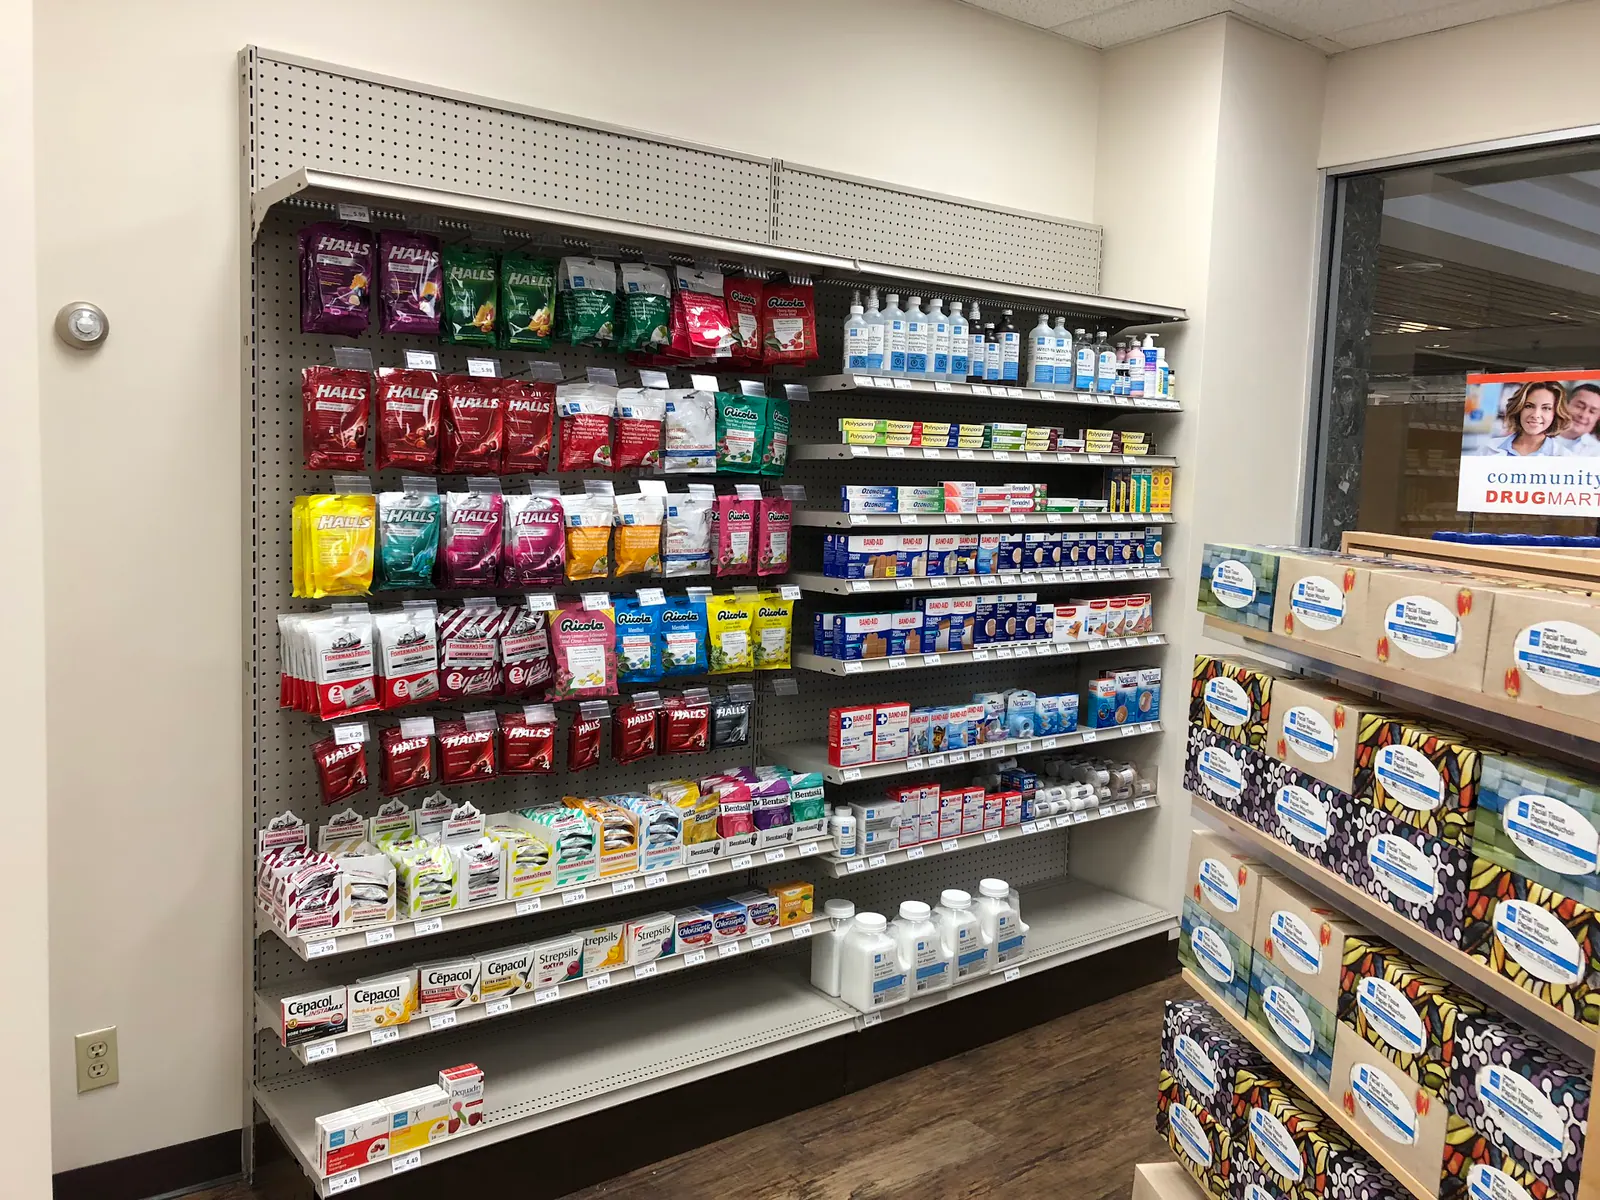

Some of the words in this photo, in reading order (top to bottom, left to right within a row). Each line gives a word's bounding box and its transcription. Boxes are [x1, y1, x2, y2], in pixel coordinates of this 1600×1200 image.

[319, 237, 370, 255] HALLS
[389, 245, 439, 262] HALLS
[450, 266, 494, 280] HALLS
[509, 273, 552, 287] HALLS
[768, 297, 806, 308] Ricola
[316, 384, 366, 400] HALLS
[386, 385, 438, 400] HALLS
[453, 396, 499, 409] HALLS
[509, 400, 549, 412] HALLS
[724, 406, 758, 420] Ricola
[1488, 470, 1600, 489] community
[1486, 491, 1600, 506] DRUGMART
[386, 509, 436, 523] HALLS
[453, 509, 498, 523] HALLS
[516, 512, 560, 525] HALLS
[728, 510, 751, 522] Ricola
[768, 511, 790, 522] Ricola
[318, 515, 371, 530] HALLS
[663, 609, 699, 622] Ricola
[717, 610, 749, 621] Ricola
[758, 607, 788, 618] Ricola
[1406, 605, 1417, 613] Facial
[1418, 608, 1431, 616] Tissue
[618, 612, 653, 624] Ricola
[1405, 612, 1417, 620] Papier
[1418, 616, 1438, 625] Mouchoir
[561, 619, 604, 632] Ricola
[1543, 632, 1558, 641] Facial
[1560, 635, 1577, 645] Tissue
[390, 648, 419, 658] FISHERMAN'S
[418, 644, 436, 653] FRIEND
[1542, 641, 1560, 651] Papier
[1560, 645, 1587, 656] Mouchoir
[325, 651, 354, 661] FISHERMAN'S
[354, 650, 371, 658] FRIEND
[403, 655, 424, 663] ORIGINAL
[452, 674, 460, 682] 2
[1118, 675, 1137, 683] Nexcare
[1142, 673, 1159, 681] Nexcare
[398, 680, 406, 690] 2
[332, 686, 341, 697] 2
[673, 709, 706, 720] HALLS
[717, 705, 746, 717] HALLS
[627, 711, 653, 727] HALLS
[853, 714, 871, 722] BAND-AID
[911, 716, 928, 724] BAND-AID
[511, 727, 550, 739] HALLS
[579, 720, 600, 735] HALLS
[446, 730, 489, 748] HALLS
[391, 738, 428, 756] HALLS
[325, 742, 362, 767] HALLS
[1394, 753, 1405, 763] Facial
[1405, 757, 1418, 768] Tissue
[484, 765, 492, 774] 4
[543, 761, 550, 769] 4
[1393, 760, 1405, 770] Papier
[1406, 765, 1424, 778] Mouchoir
[359, 776, 367, 785] 4
[423, 771, 430, 779] 4
[795, 788, 822, 799] Bentasil
[762, 796, 789, 806] Bentasil
[724, 803, 751, 813] Bentasil
[1531, 806, 1549, 818] Facial
[1549, 813, 1566, 824] Tissue
[797, 824, 817, 832] Bentasil
[1530, 814, 1548, 827] Papier
[1548, 821, 1575, 837] Mouchoir
[729, 837, 751, 847] Bentasil
[766, 832, 787, 841] Bentasil
[601, 855, 624, 863] FISHERMAN'S
[624, 851, 637, 859] FRIEND
[646, 849, 667, 857] FISHERMAN'S
[667, 845, 680, 853] FRIEND
[691, 847, 713, 856] Bentasil
[557, 863, 581, 871] FISHERMAN'S
[581, 859, 595, 867] FRIEND
[513, 874, 537, 883] FISHERMAN'S
[750, 905, 777, 917] Chloraseptic
[715, 916, 746, 928] Chloraseptic
[1519, 907, 1534, 920] Facial
[1534, 917, 1550, 932] Tissue
[637, 925, 671, 942] Strepsils
[679, 922, 712, 936] Chloraseptic
[1518, 916, 1532, 929] Papier
[1532, 924, 1559, 946] Mouchoir
[539, 947, 578, 964] Strepsils
[542, 961, 564, 970] extra
[308, 1003, 344, 1016] INSTAMAX
[442, 1016, 455, 1024] 6.79
[382, 1031, 396, 1039] 6.49
[319, 1047, 334, 1055] 6.79
[452, 1084, 482, 1098] Dequadin
[1503, 1078, 1517, 1091] Facial
[1518, 1090, 1533, 1104] Tissue
[1502, 1086, 1515, 1099] Papier
[1515, 1094, 1543, 1119] Mouchoir
[405, 1156, 418, 1165] 4.49
[343, 1176, 357, 1185] 4.49
